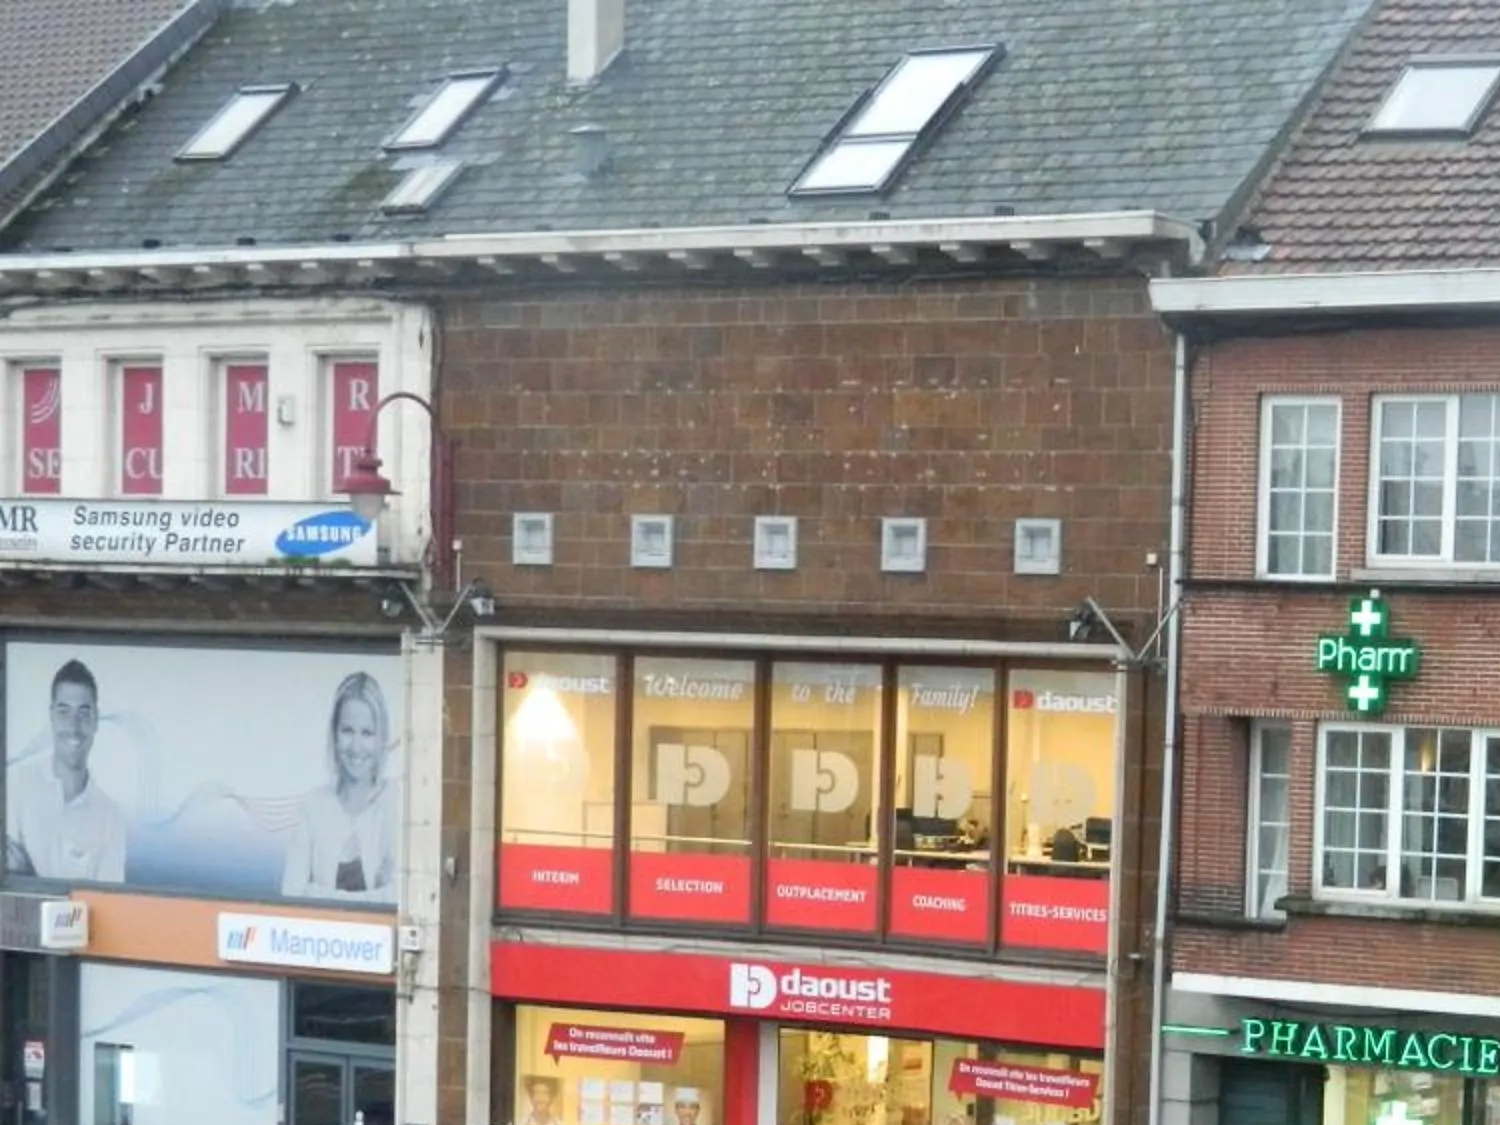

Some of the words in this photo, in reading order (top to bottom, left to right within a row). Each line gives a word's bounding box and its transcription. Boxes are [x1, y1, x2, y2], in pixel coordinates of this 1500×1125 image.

[73, 505, 171, 531] Samsung
[181, 509, 239, 528] video
[70, 534, 156, 556] security
[165, 533, 245, 553] Partner
[287, 524, 362, 543] SAMSUNG
[643, 673, 743, 700] Welcome
[1036, 689, 1118, 714] daoust
[655, 877, 723, 894] SELECTION
[777, 883, 867, 904] OUTPLACEMENT
[912, 894, 966, 912] COACHING
[1008, 901, 1107, 923] TITRES-SERVICES
[271, 927, 383, 962] Manpower
[781, 968, 892, 1003] daoust
[780, 1000, 891, 1020] JOBCENTER
